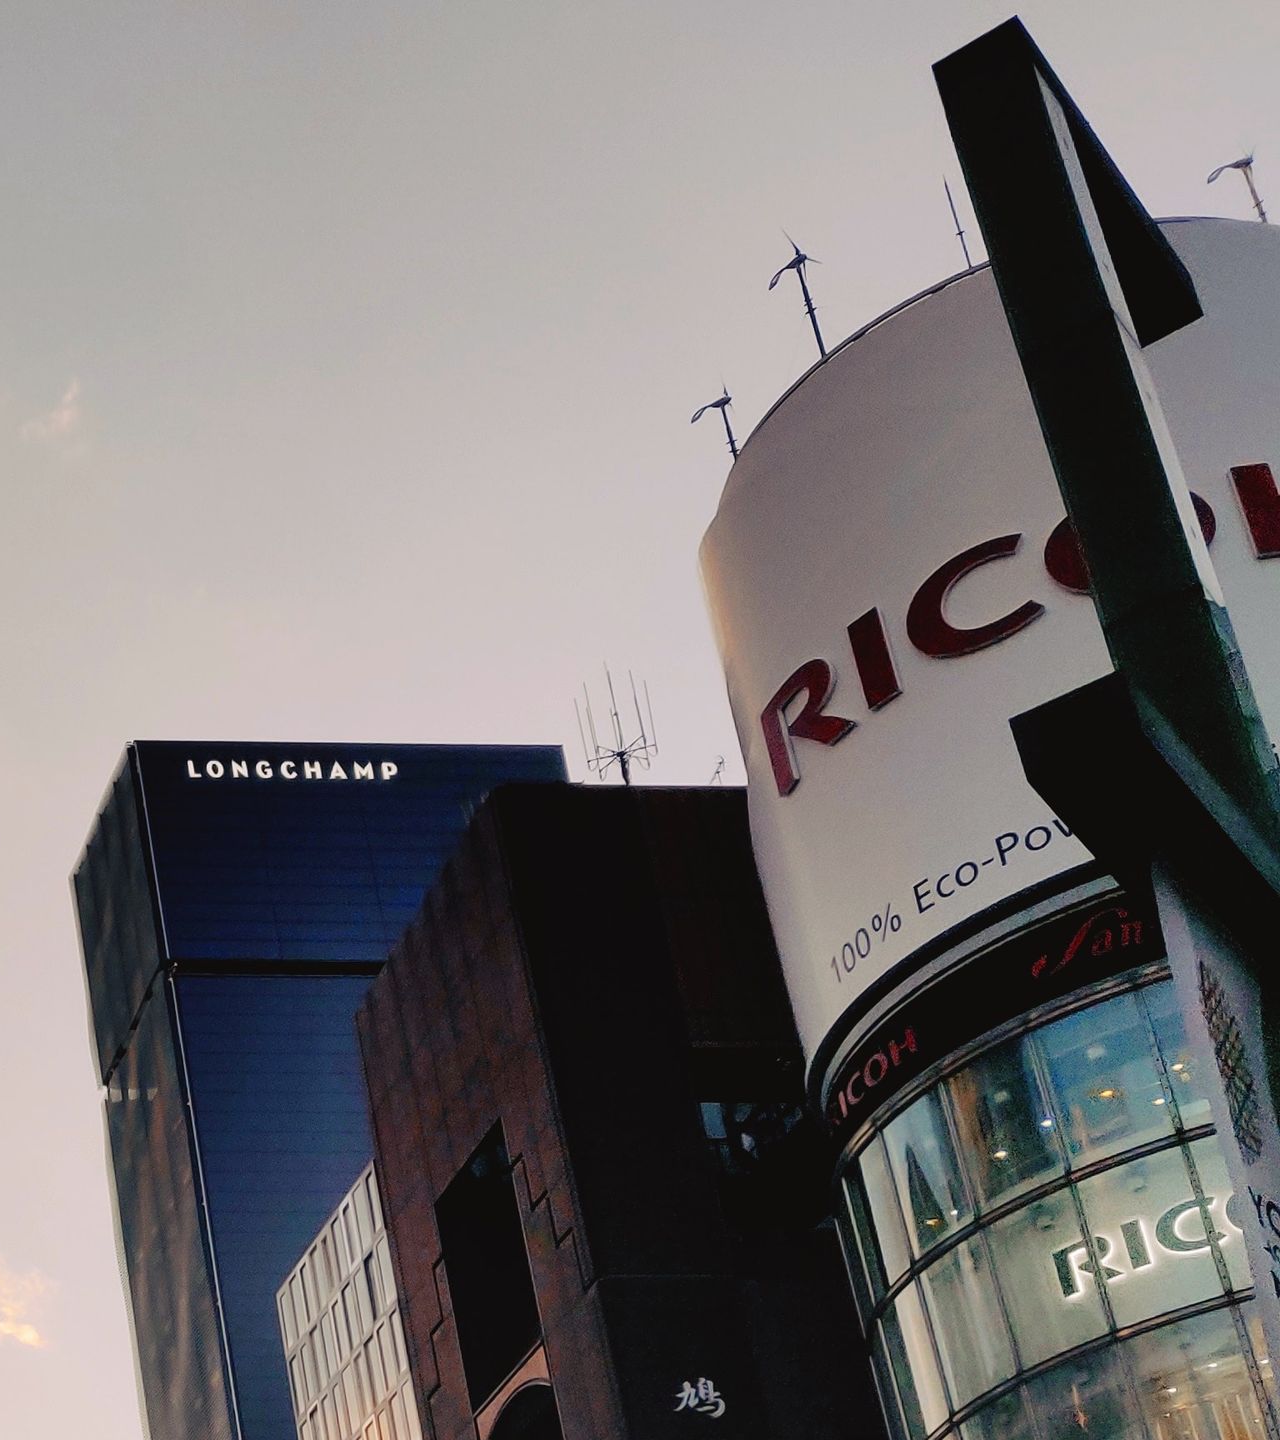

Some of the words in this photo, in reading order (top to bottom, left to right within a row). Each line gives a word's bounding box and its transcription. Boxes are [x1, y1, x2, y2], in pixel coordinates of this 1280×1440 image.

[187, 760, 398, 780] LONGCHAMP
[831, 903, 902, 983] 100%
[831, 1028, 918, 1126] ICOH
